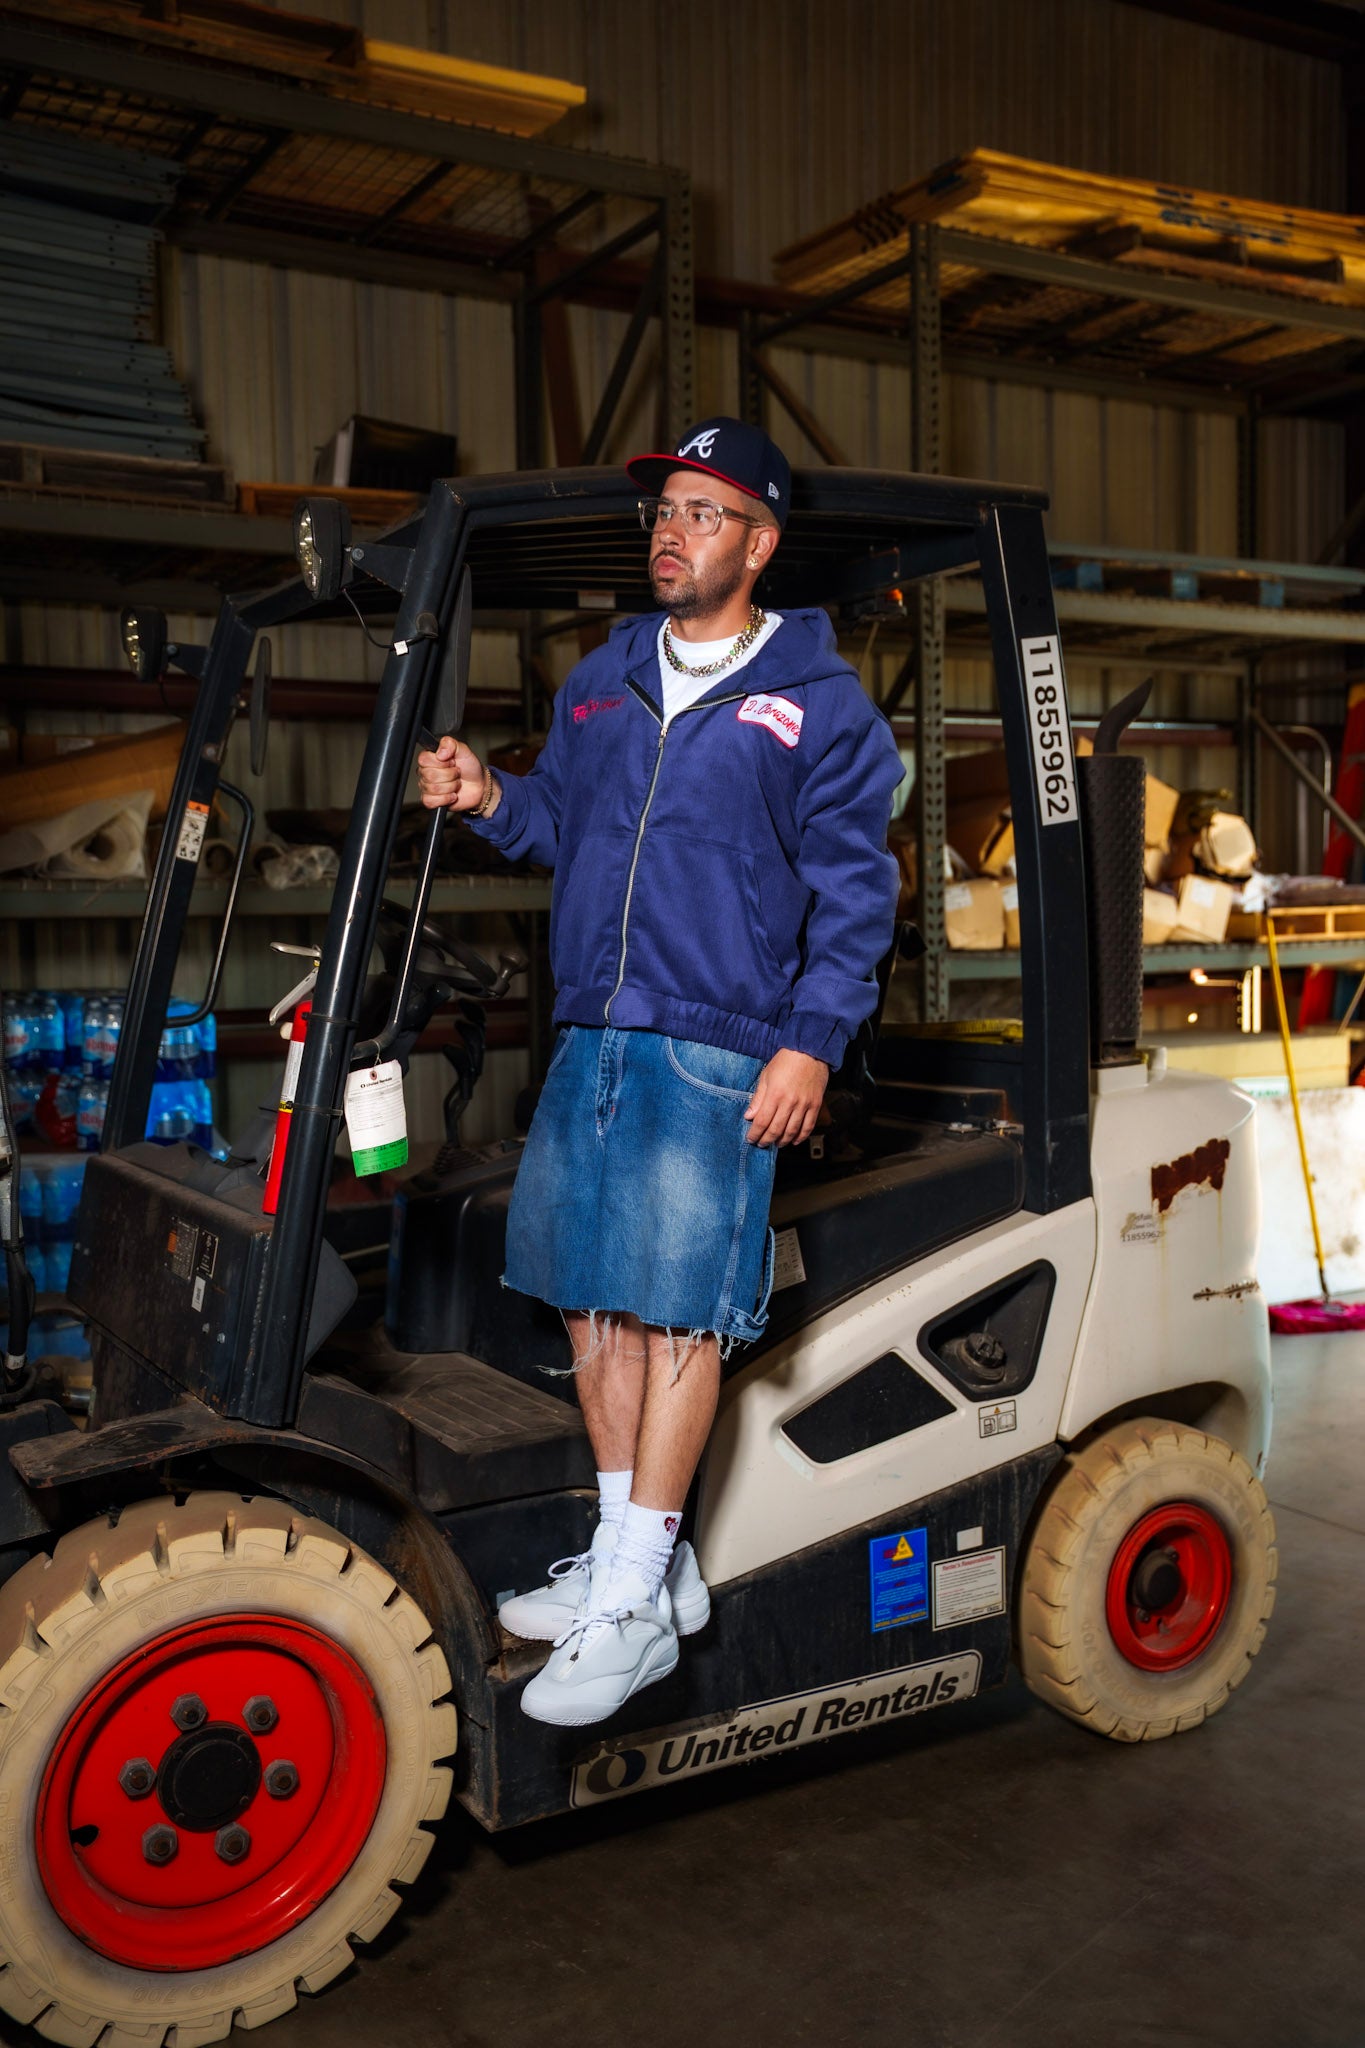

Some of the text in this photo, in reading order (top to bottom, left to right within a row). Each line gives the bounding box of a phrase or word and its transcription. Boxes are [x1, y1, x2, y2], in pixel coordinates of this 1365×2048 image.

[678, 428, 720, 459] A
[1029, 640, 1070, 818] 11855962
[136, 1579, 278, 1629] NEXEN
[657, 1670, 960, 1776] United Rentals
[132, 1983, 178, 2005] 700
